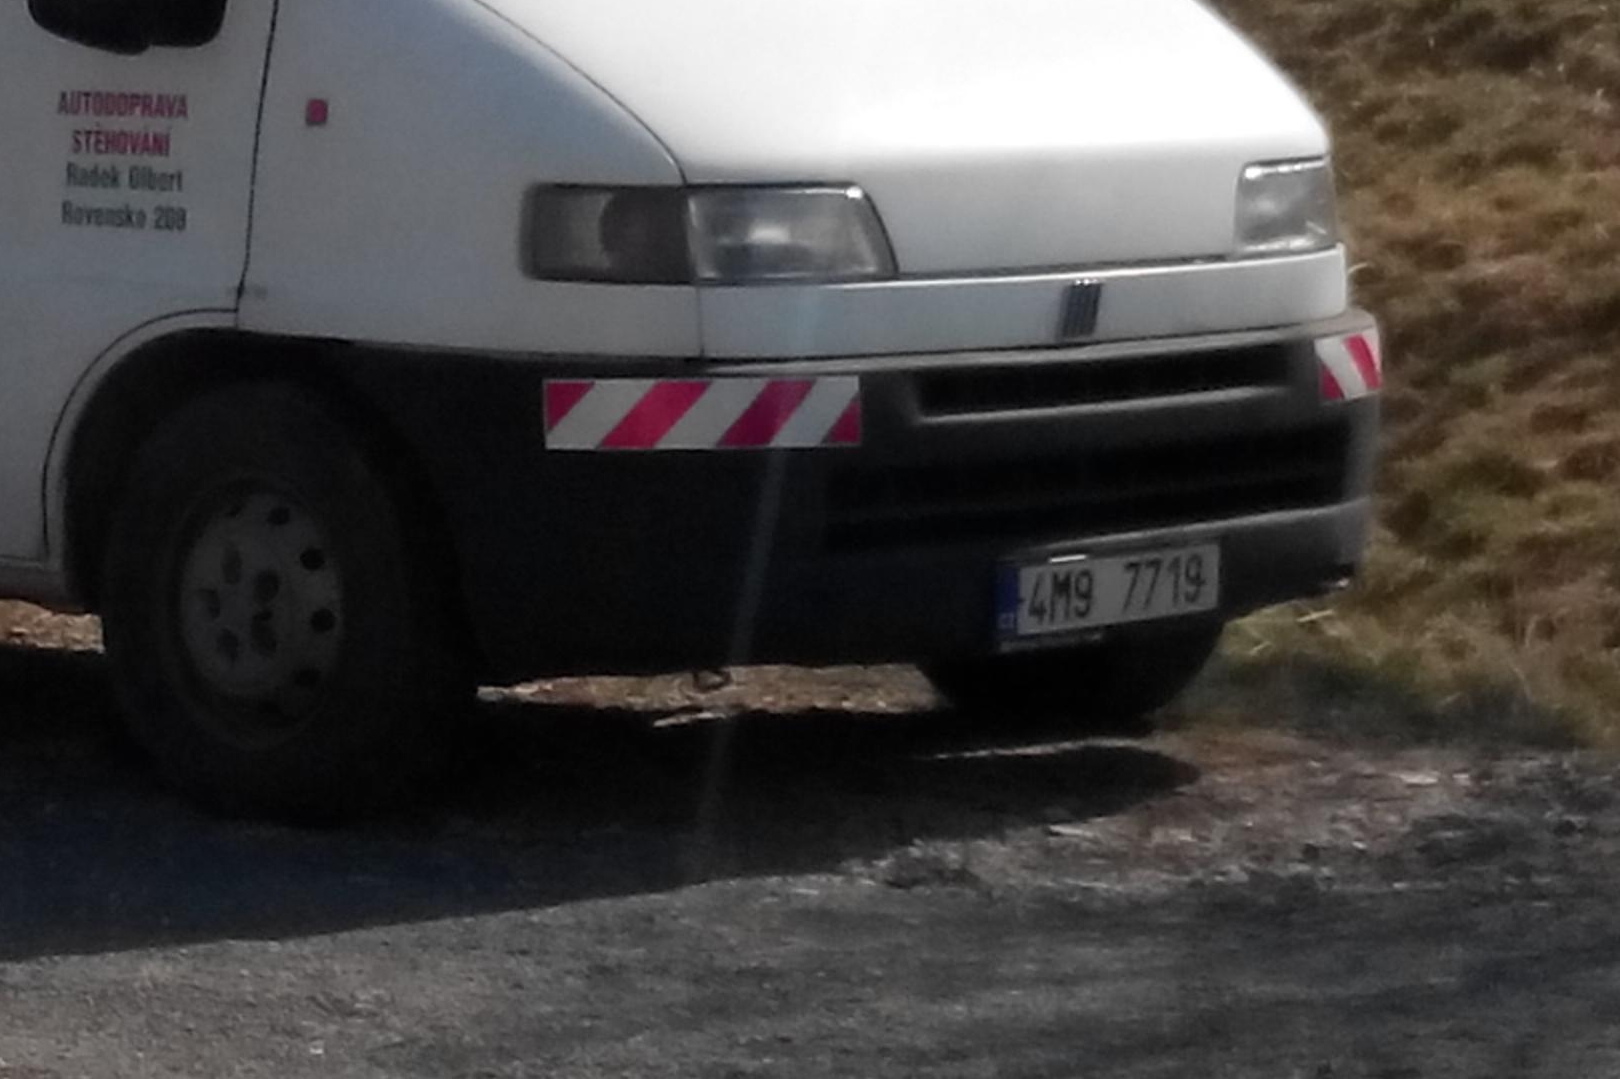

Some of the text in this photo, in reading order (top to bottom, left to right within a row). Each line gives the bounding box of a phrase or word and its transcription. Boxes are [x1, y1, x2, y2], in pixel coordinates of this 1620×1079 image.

[58, 90, 189, 119] AUTODOPRAVA
[1028, 553, 1206, 626] 4M9 7719
